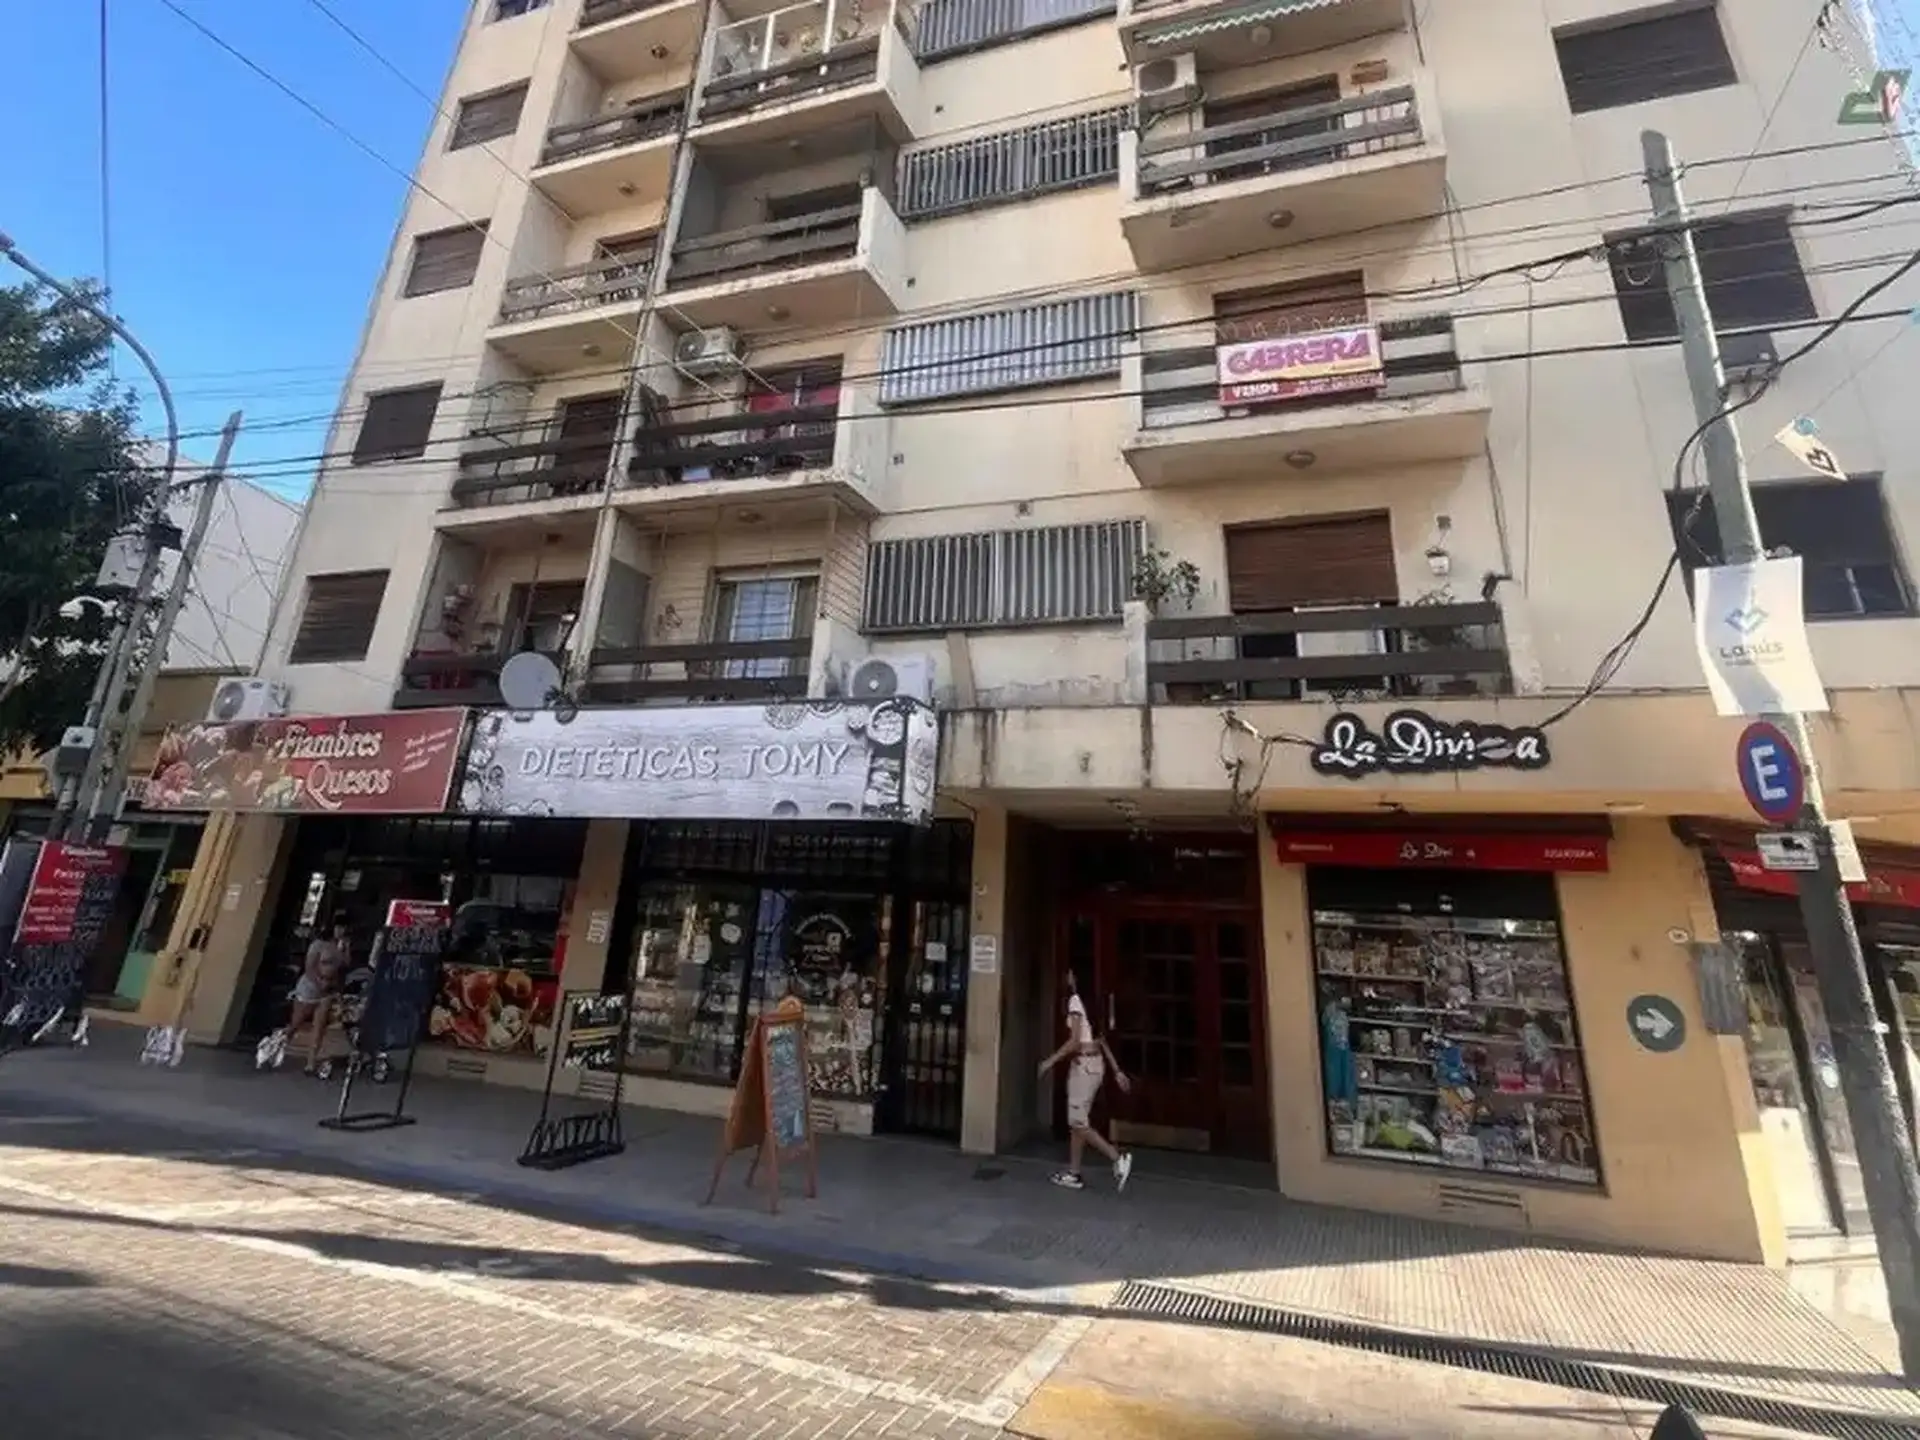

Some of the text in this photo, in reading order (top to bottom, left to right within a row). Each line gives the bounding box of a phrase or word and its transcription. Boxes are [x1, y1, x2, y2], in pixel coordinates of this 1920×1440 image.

[1228, 332, 1371, 374] CABRERA
[277, 720, 383, 758] Fiambres
[520, 737, 849, 779] DIETÉTICAS TOMY
[1320, 718, 1541, 767] La Divia
[306, 759, 394, 810] Quesos
[1751, 744, 1788, 800] E
